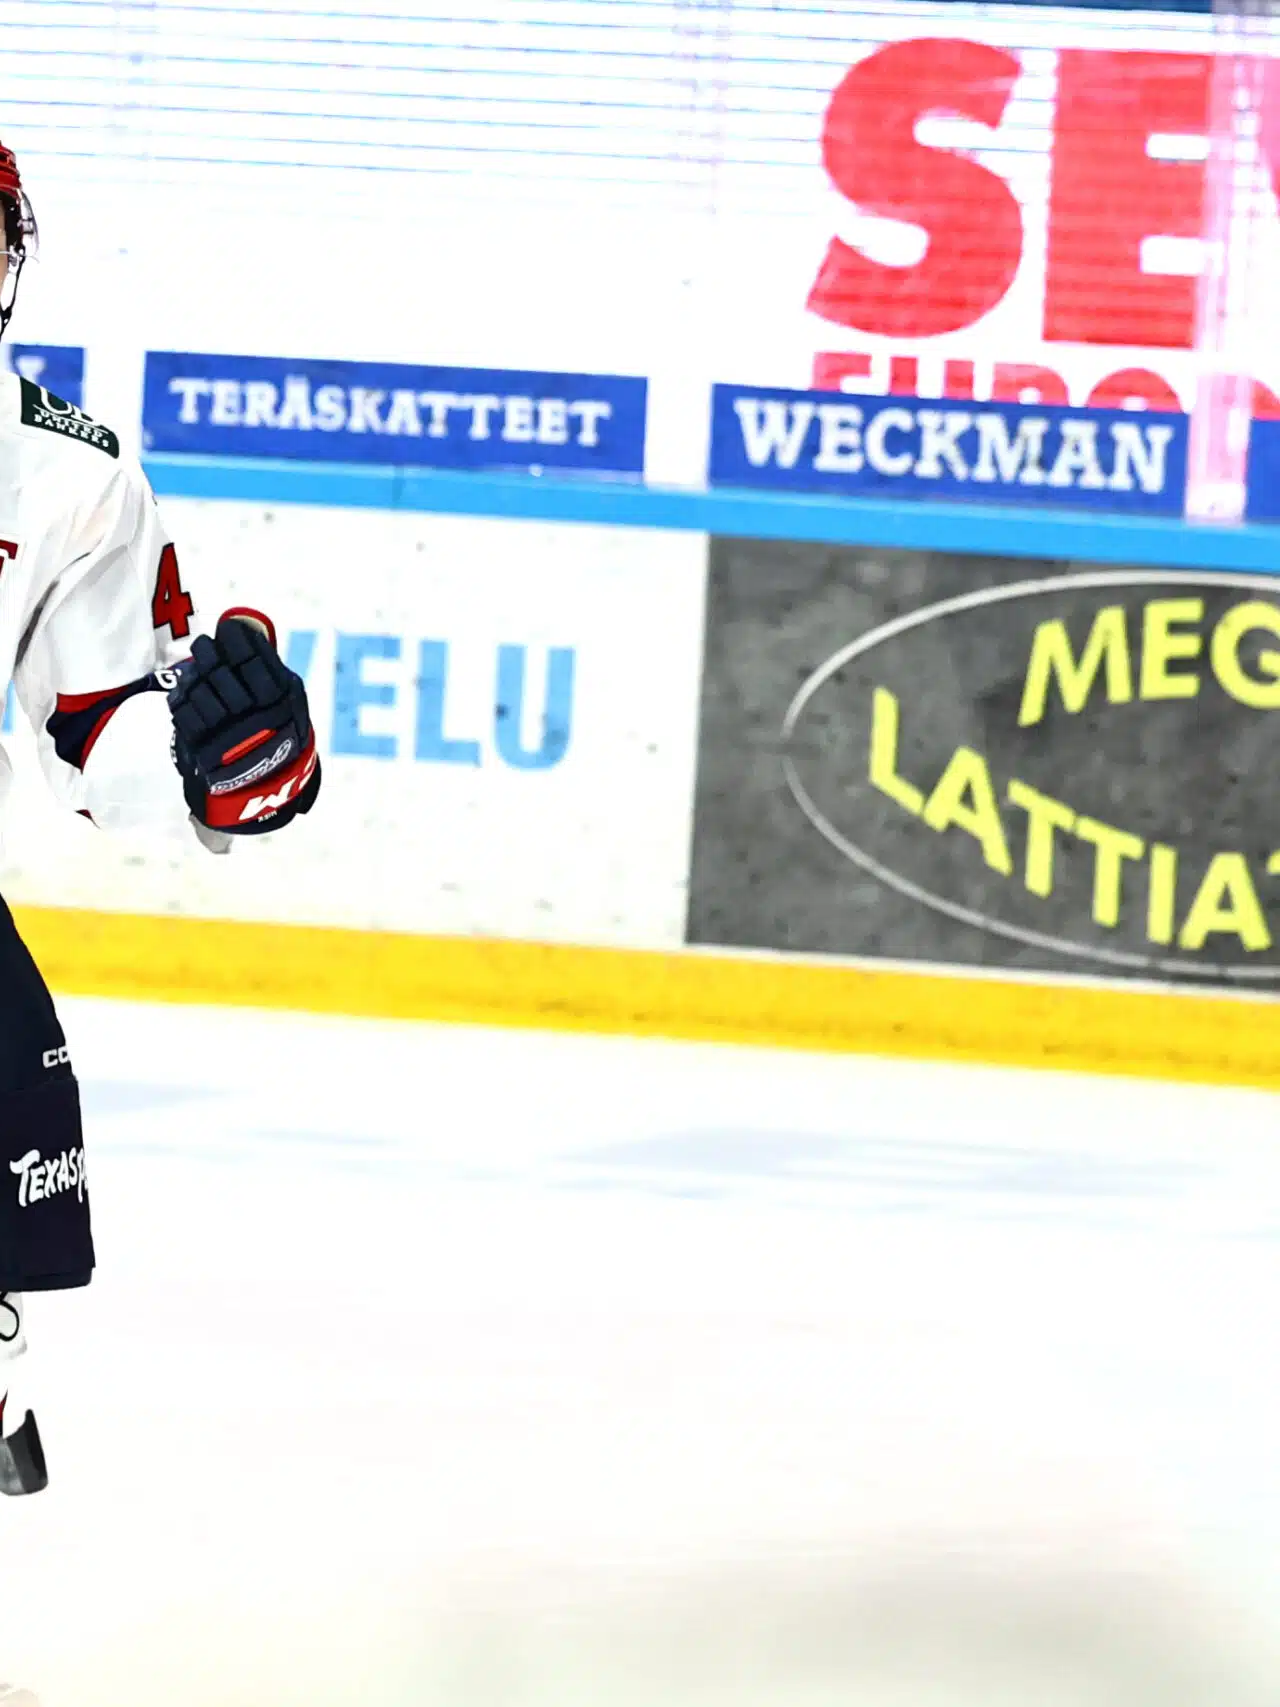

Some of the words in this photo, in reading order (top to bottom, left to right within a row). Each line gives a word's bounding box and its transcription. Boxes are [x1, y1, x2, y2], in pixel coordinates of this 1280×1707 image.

[806, 37, 1280, 350] SE
[33, 413, 110, 449] BANKERS
[39, 409, 103, 438] UNITED
[168, 375, 612, 448] TERÄSKATTEET
[731, 397, 1176, 493] WECKMAN
[152, 542, 194, 640] 4
[867, 685, 1280, 951] LATTIA
